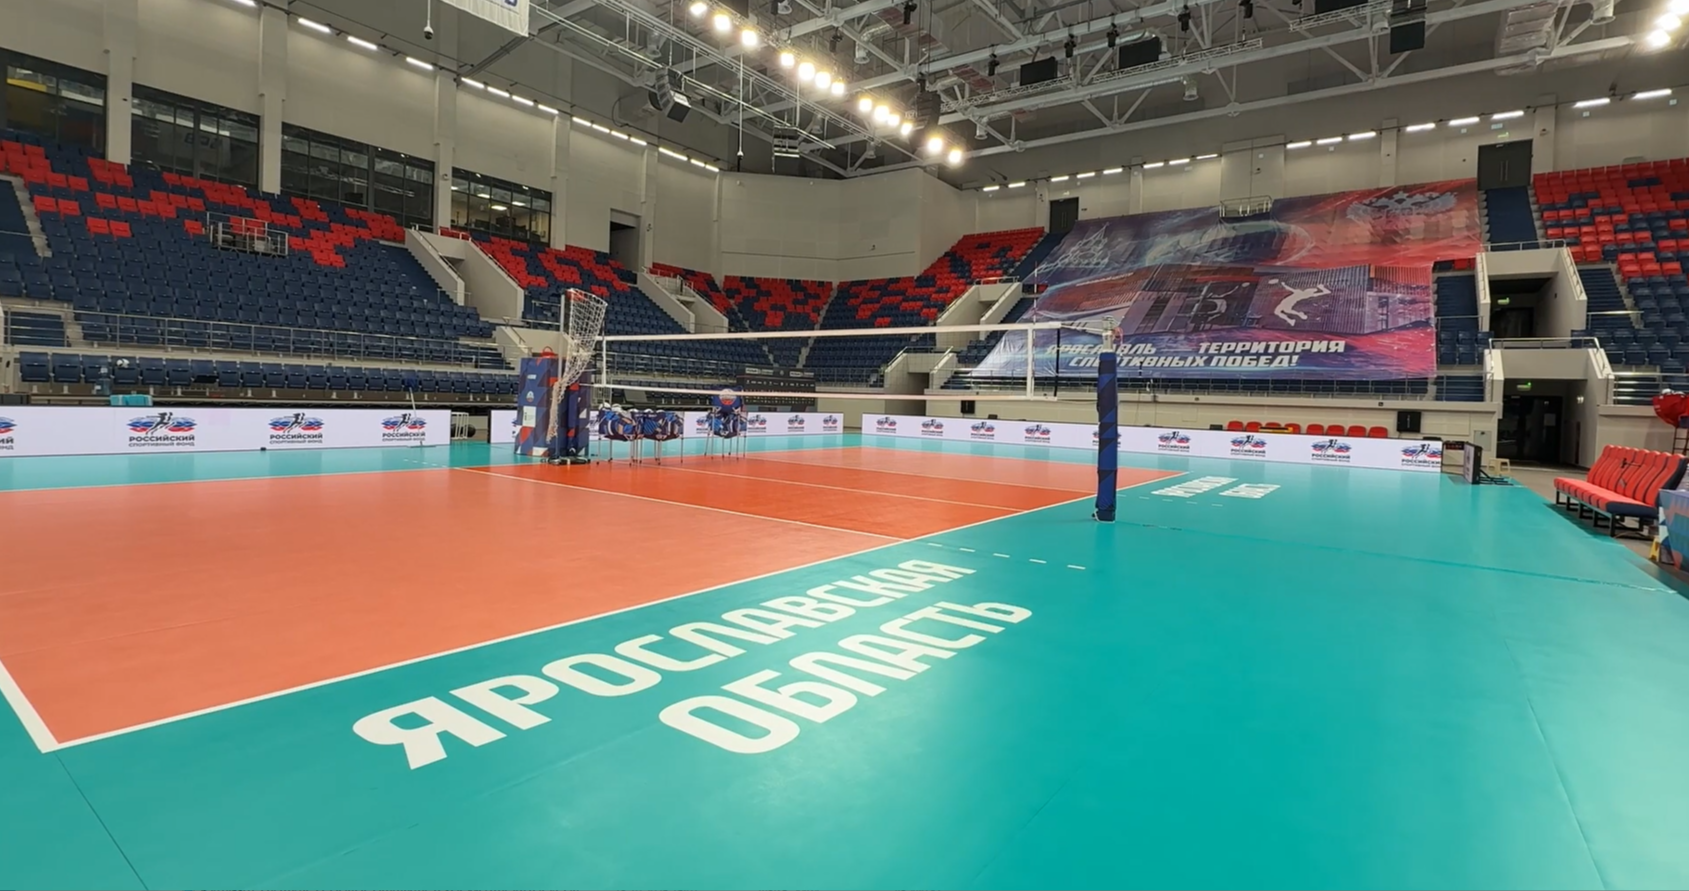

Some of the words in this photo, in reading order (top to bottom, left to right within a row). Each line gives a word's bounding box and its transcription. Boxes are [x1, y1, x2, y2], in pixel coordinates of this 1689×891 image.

[1045, 343, 1156, 354] ЯРОСЛВЛЬ
[1198, 340, 1346, 354] ТЕРРИТОРИЯ
[1210, 355, 1299, 367] ПОБЕД!
[129, 434, 195, 442] РОССИЙСКИЙ
[353, 559, 976, 769] ЯРОСЛАВСКАЯ
[659, 601, 1031, 754] ОБЛАСТЬ
